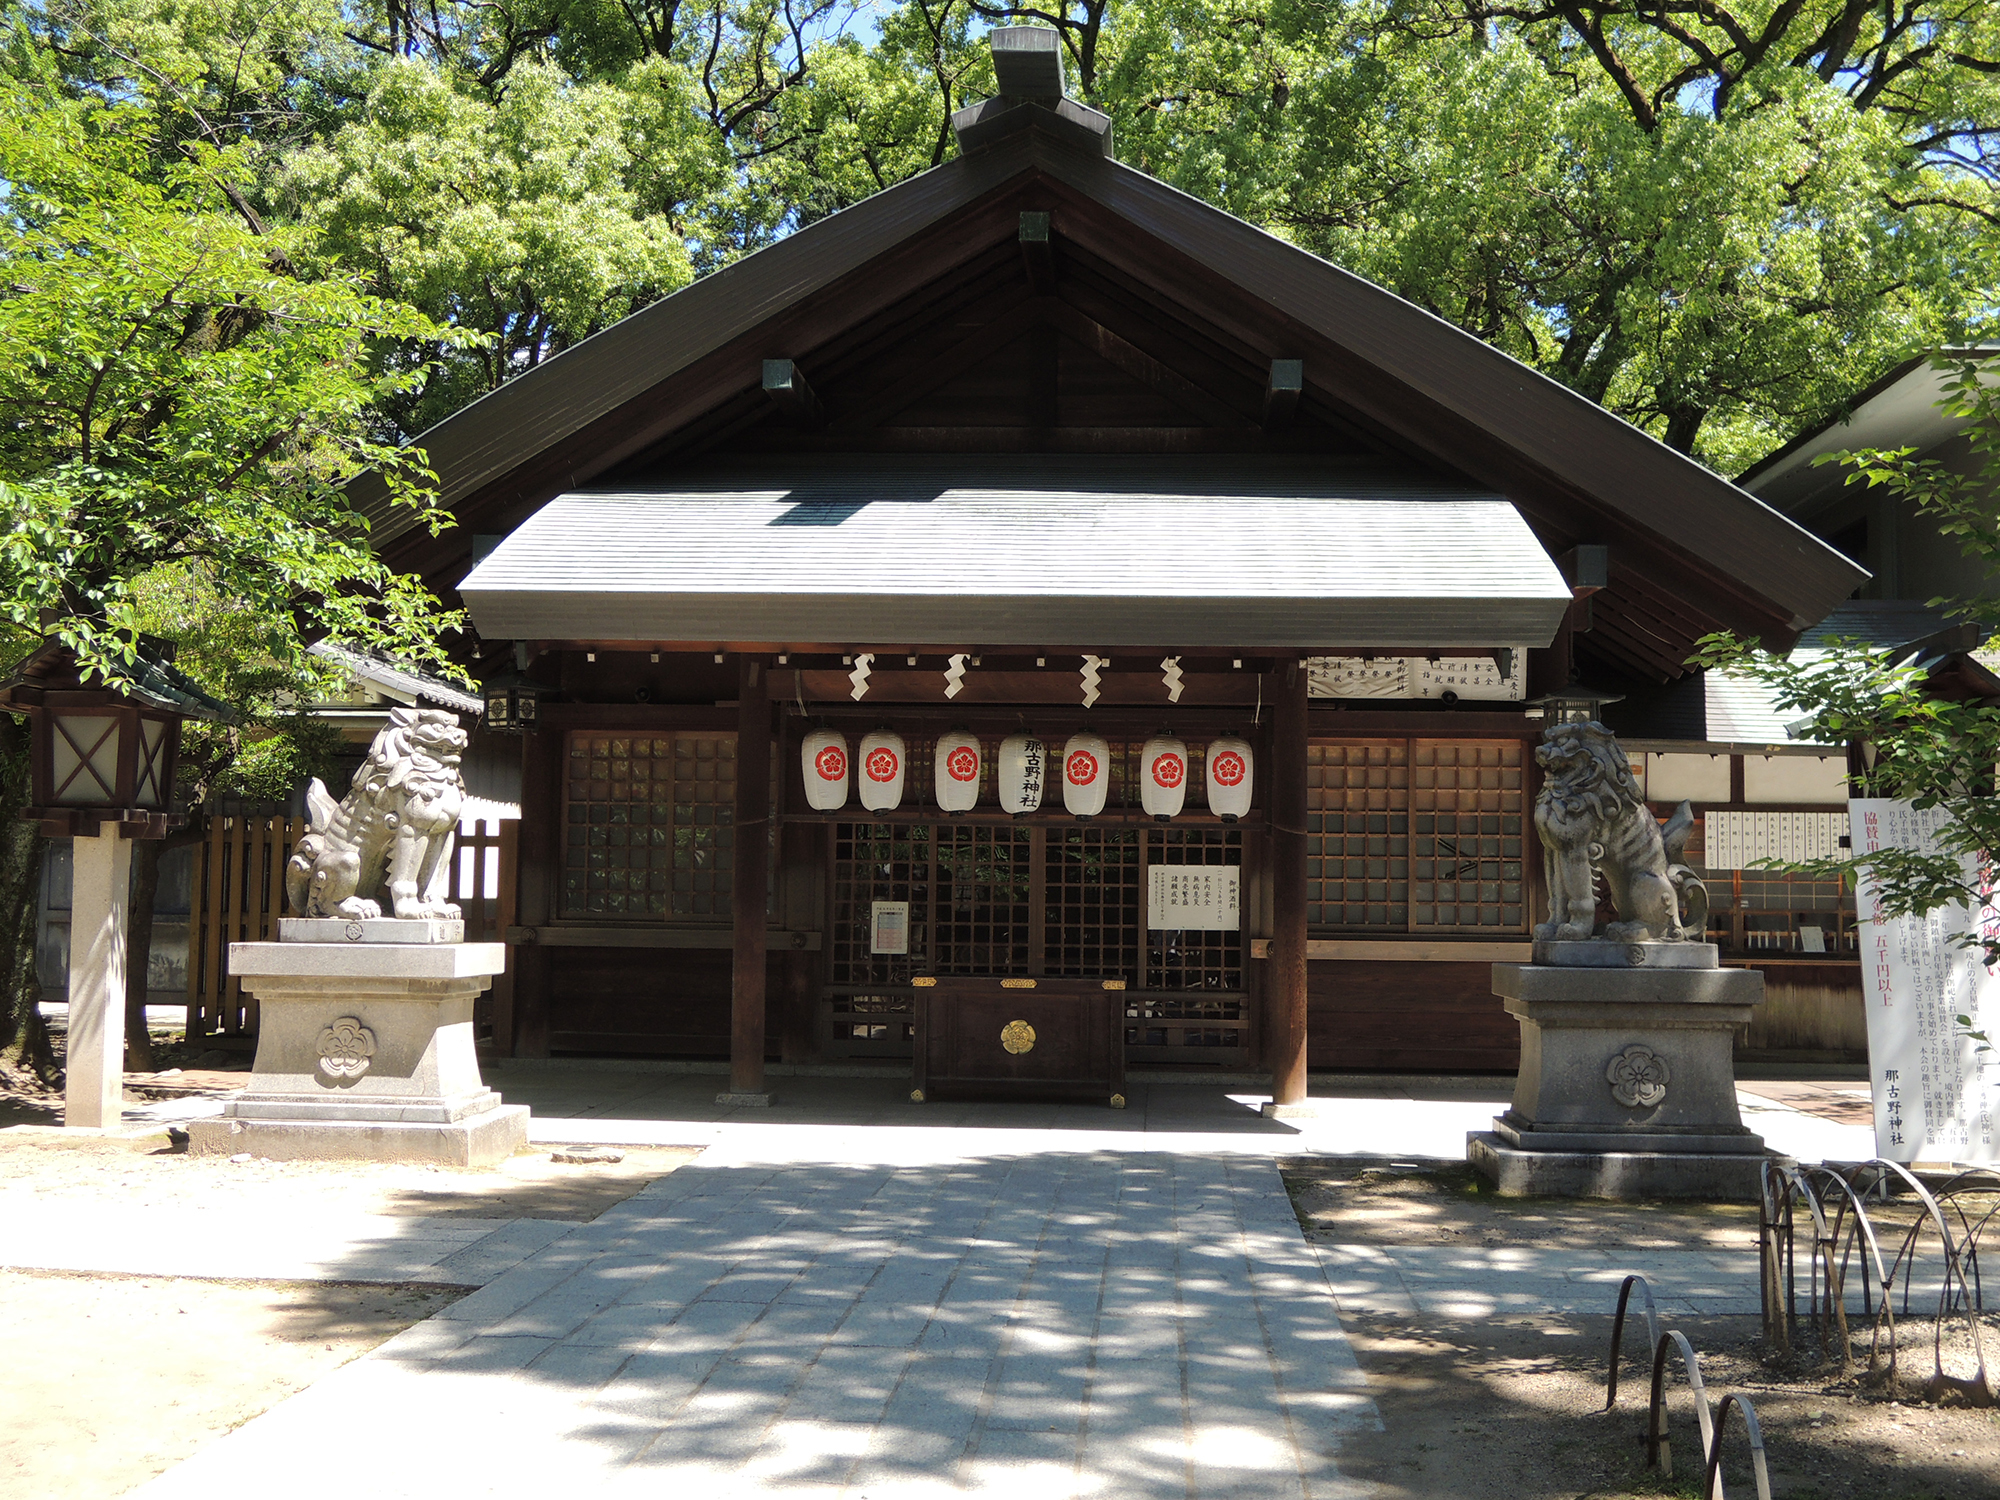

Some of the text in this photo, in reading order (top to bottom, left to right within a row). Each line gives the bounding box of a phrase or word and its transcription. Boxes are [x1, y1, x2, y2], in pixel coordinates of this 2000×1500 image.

[1019, 740, 1042, 808] 那古野神社
[1203, 875, 1211, 906] 家内安全
[1864, 811, 1893, 1008] 協賛申金額 五千円以上
[1885, 1069, 1905, 1146] 那古野神社
